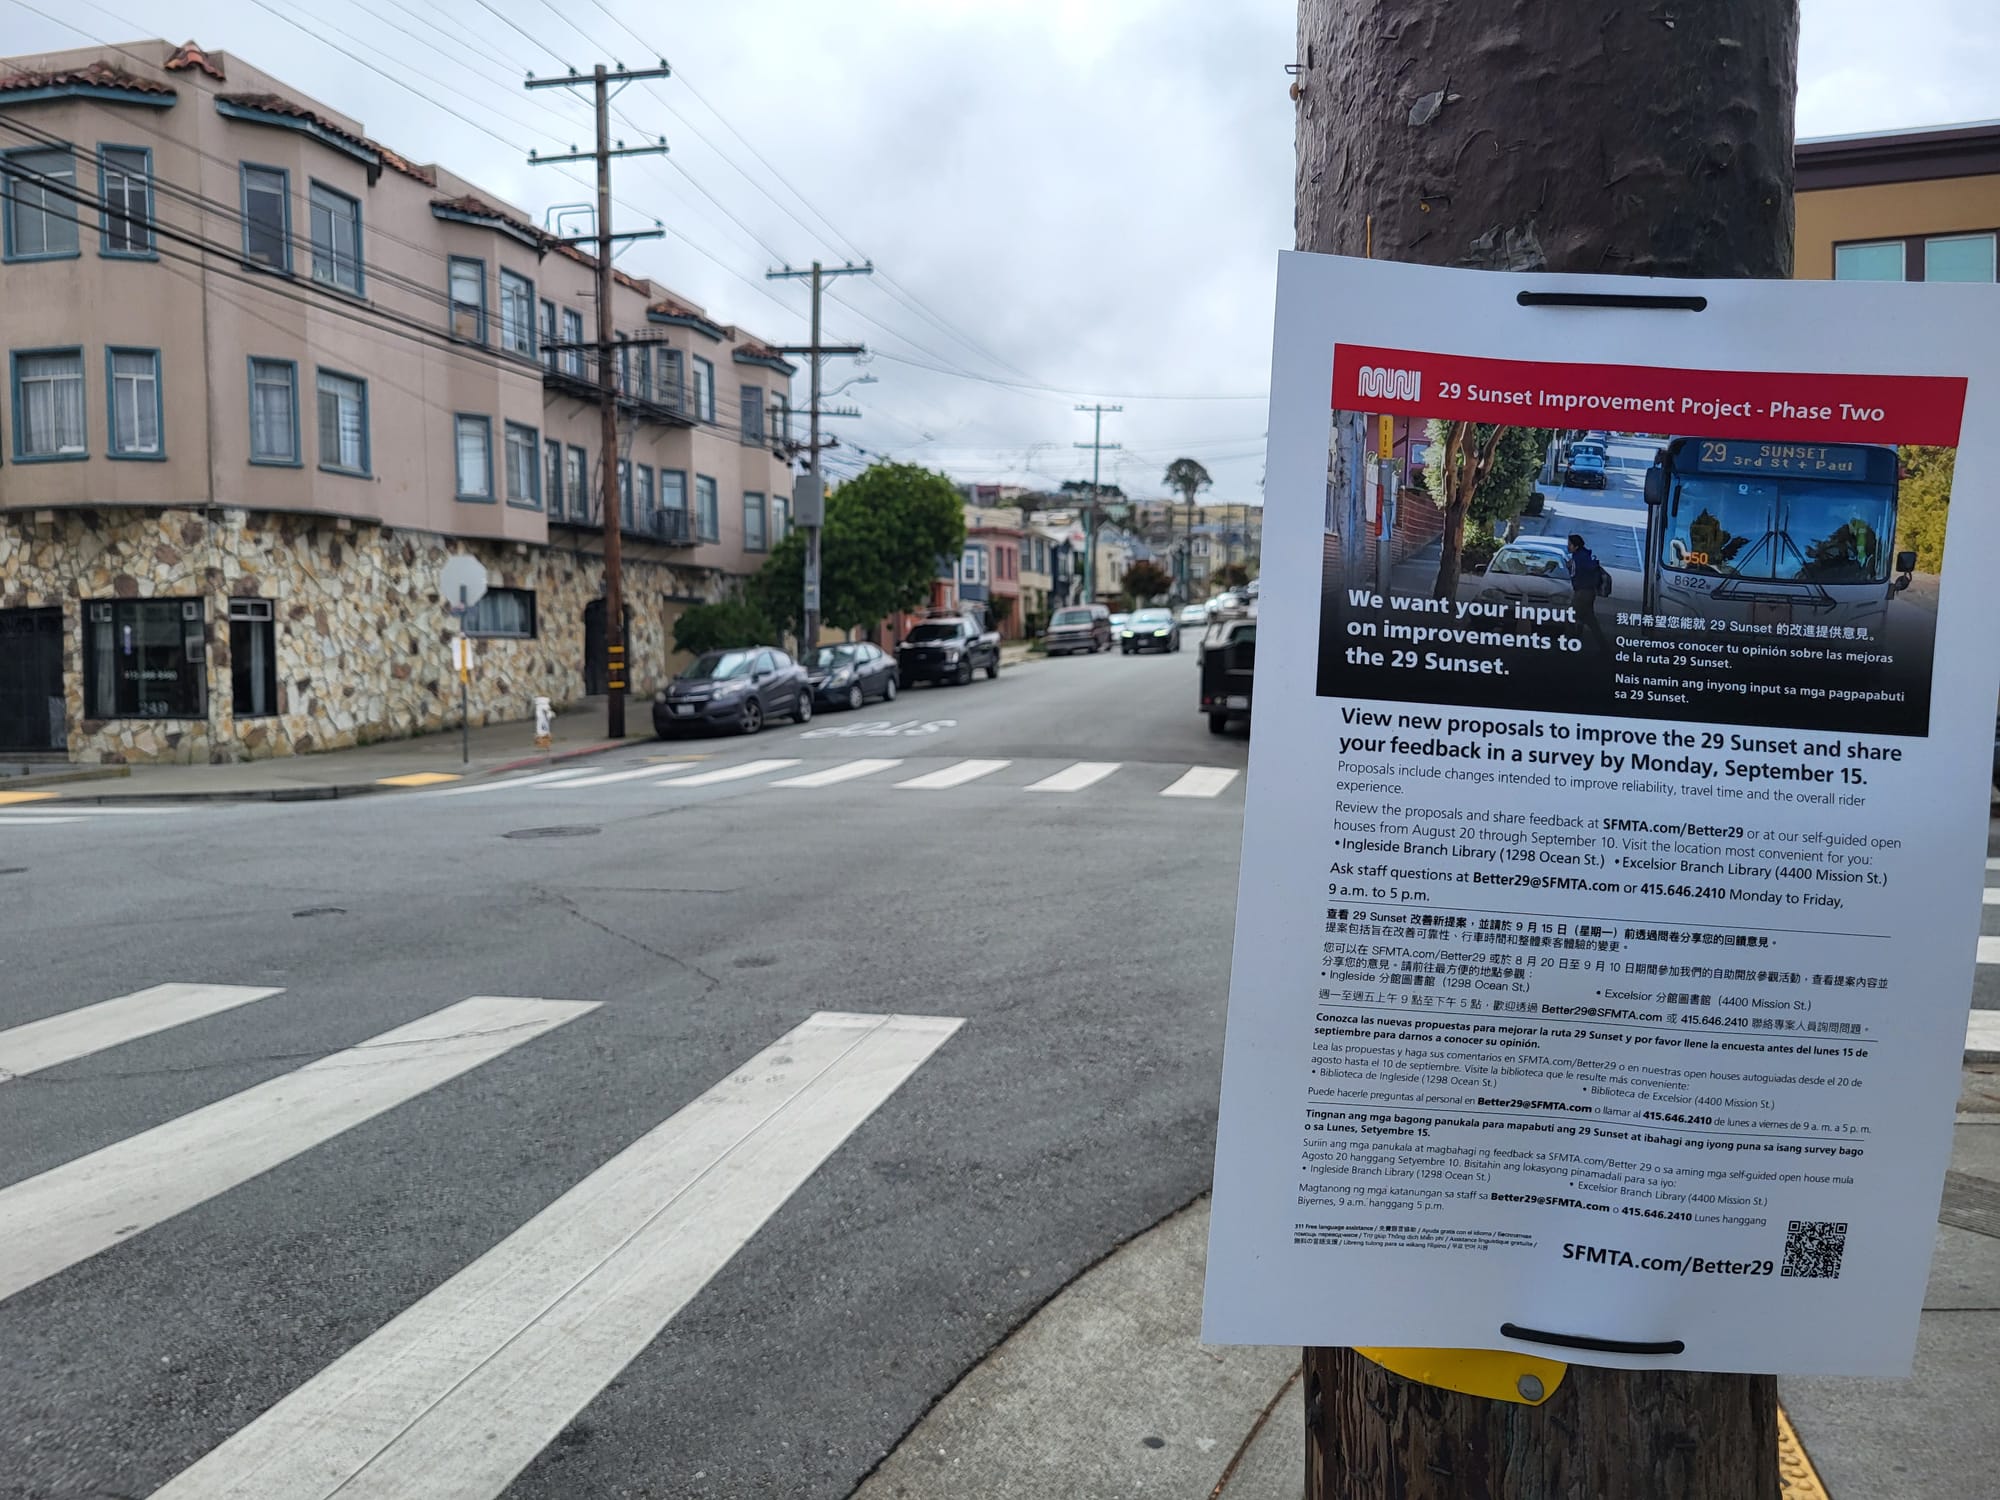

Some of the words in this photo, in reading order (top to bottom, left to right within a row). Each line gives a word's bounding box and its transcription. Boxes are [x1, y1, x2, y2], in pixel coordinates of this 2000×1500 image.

[1358, 366, 1421, 401] MUNI
[1438, 381, 1461, 399] 29
[1466, 384, 1532, 406] Sunset
[1538, 389, 1675, 413] Improvement
[1681, 397, 1752, 420] Project
[1769, 400, 1832, 420] Phase
[1838, 403, 1885, 421] Two
[1701, 441, 1727, 462] 29
[1732, 455, 1762, 467] 3rd
[1769, 457, 1789, 468] St
[1759, 445, 1828, 460] SUNSET
[1674, 575, 1706, 590] 8622
[1348, 588, 1384, 609] We
[1389, 595, 1449, 614] want
[1455, 600, 1509, 619] your
[1514, 600, 1576, 625] input
[1346, 621, 1377, 637] on
[1383, 619, 1551, 650] improvements
[1557, 634, 1582, 652] to
[1616, 612, 1706, 631] 我們希望您能就
[1709, 619, 1726, 631] 29
[1729, 620, 1772, 634] Sunset
[1344, 646, 1384, 666] the
[1390, 649, 1418, 668] 29
[1424, 652, 1509, 675] Sunset.
[1615, 635, 1676, 650] Queremos
[1677, 642, 1724, 653] conocer
[1726, 643, 1739, 654] tu
[1741, 644, 1787, 657] opinión
[1789, 647, 1824, 659] sobre
[1825, 648, 1842, 660] las
[1845, 651, 1893, 664] mejoras
[1615, 650, 1630, 662] de
[1632, 651, 1643, 663] la
[1646, 654, 1670, 665] ruta
[1672, 654, 1687, 666] 29
[1689, 656, 1732, 669] Sunset.
[1614, 672, 1640, 685] Nais
[1642, 676, 1679, 688] namin
[1681, 679, 1704, 692] ang
[1706, 678, 1747, 694] inyong
[1749, 681, 1781, 696] input
[1783, 686, 1797, 695] sa
[1799, 687, 1826, 699] mga
[1828, 689, 1905, 702] pagpapabuti
[1614, 690, 1627, 699] sa
[1629, 689, 1644, 700] 29
[1646, 690, 1689, 703] Sunset.
[1340, 706, 1393, 727] View
[1398, 714, 1442, 730] new
[1447, 718, 1544, 738] proposals
[1548, 722, 1570, 740] to
[1576, 722, 1657, 746] improve
[1661, 728, 1695, 748] the
[1700, 731, 1724, 750] 29
[1730, 733, 1798, 755] Sunset
[1802, 739, 1841, 758] and
[1847, 741, 1902, 762] share
[1338, 736, 1386, 755] your
[1389, 735, 1481, 759] feedback
[1487, 742, 1505, 761] in
[1510, 748, 1522, 762] a
[1528, 749, 1595, 771] survey
[1600, 749, 1625, 774] by
[1631, 752, 1718, 779] Monday,
[1724, 759, 1834, 783] September
[1840, 767, 1867, 785] 15.
[1335, 799, 1379, 814] Review
[1381, 802, 1402, 816] the
[1404, 807, 1463, 821] proposals
[1465, 809, 1490, 822] and
[1492, 810, 1526, 825] share
[1528, 812, 1584, 829] feedback
[1586, 818, 1600, 829] at
[1602, 817, 1744, 839] SFMTA.com/Better29
[1746, 830, 1760, 840] or
[1762, 830, 1775, 841] at
[1777, 832, 1799, 842] our
[1801, 831, 1867, 848] self-guided
[1870, 838, 1901, 850] open
[1342, 837, 1400, 853] Ingleside
[1403, 841, 1448, 856] Branch
[1452, 844, 1497, 862] Library
[1499, 847, 1536, 863] (1298
[1538, 850, 1581, 865] Ocean
[1583, 853, 1605, 869] St.)
[1329, 861, 1354, 875] Ask
[1356, 864, 1388, 877] staff
[1389, 867, 1453, 882] questions
[1455, 871, 1470, 883] at
[1472, 871, 1620, 893] Better29@SFMTA.com
[1622, 884, 1638, 894] or
[1640, 882, 1726, 900] 415.646.2410
[1729, 888, 1783, 906] Monday
[1785, 892, 1800, 904] to
[1802, 892, 1843, 910] Friday,
[1622, 856, 1677, 871] Excelsior
[1680, 859, 1724, 874] Branch
[1727, 862, 1772, 880] Library
[1774, 865, 1813, 881] (4400
[1815, 868, 1863, 883] Mission
[1866, 871, 1887, 887] St.)
[1328, 882, 1337, 895] 9
[1339, 886, 1368, 897] a.m.
[1371, 886, 1386, 898] to
[1389, 886, 1398, 899] 5
[1400, 890, 1430, 903] p.m.
[1314, 1026, 1371, 1038] septiembre
[1372, 1031, 1396, 1040] para
[1398, 1030, 1433, 1042] darnos
[1443, 1035, 1484, 1045] conocer
[1484, 1038, 1497, 1046] su
[1499, 1037, 1540, 1049] opinión.
[1315, 1012, 1358, 1024] Conozca
[1360, 1014, 1375, 1025] las
[1376, 1018, 1413, 1028] nuevas
[1413, 1020, 1471, 1031] propuestas
[1472, 1024, 1496, 1034] para
[1497, 1024, 1538, 1036] mejorar
[1539, 1026, 1549, 1036] la
[1550, 1028, 1572, 1038] ruta
[1573, 1029, 1587, 1039] 29
[1588, 1030, 1624, 1042] Sunset
[1624, 1035, 1633, 1044] y
[1633, 1036, 1653, 1045] por
[1654, 1035, 1682, 1047] favor
[1683, 1038, 1708, 1049] llene
[1710, 1039, 1719, 1050] la
[1721, 1042, 1765, 1052] encuesta
[1766, 1044, 1794, 1054] antes
[1795, 1044, 1812, 1055] del
[1813, 1045, 1840, 1056] lunes
[1842, 1047, 1854, 1057] 15
[1854, 1047, 1868, 1058] de
[1304, 1123, 1311, 1131] o
[1312, 1123, 1324, 1131] sa
[1326, 1122, 1358, 1134] Lunes,
[1360, 1124, 1415, 1137] Setyembre
[1417, 1127, 1430, 1137] 15.
[1562, 1242, 1774, 1276] SFMTA.com/Better29
